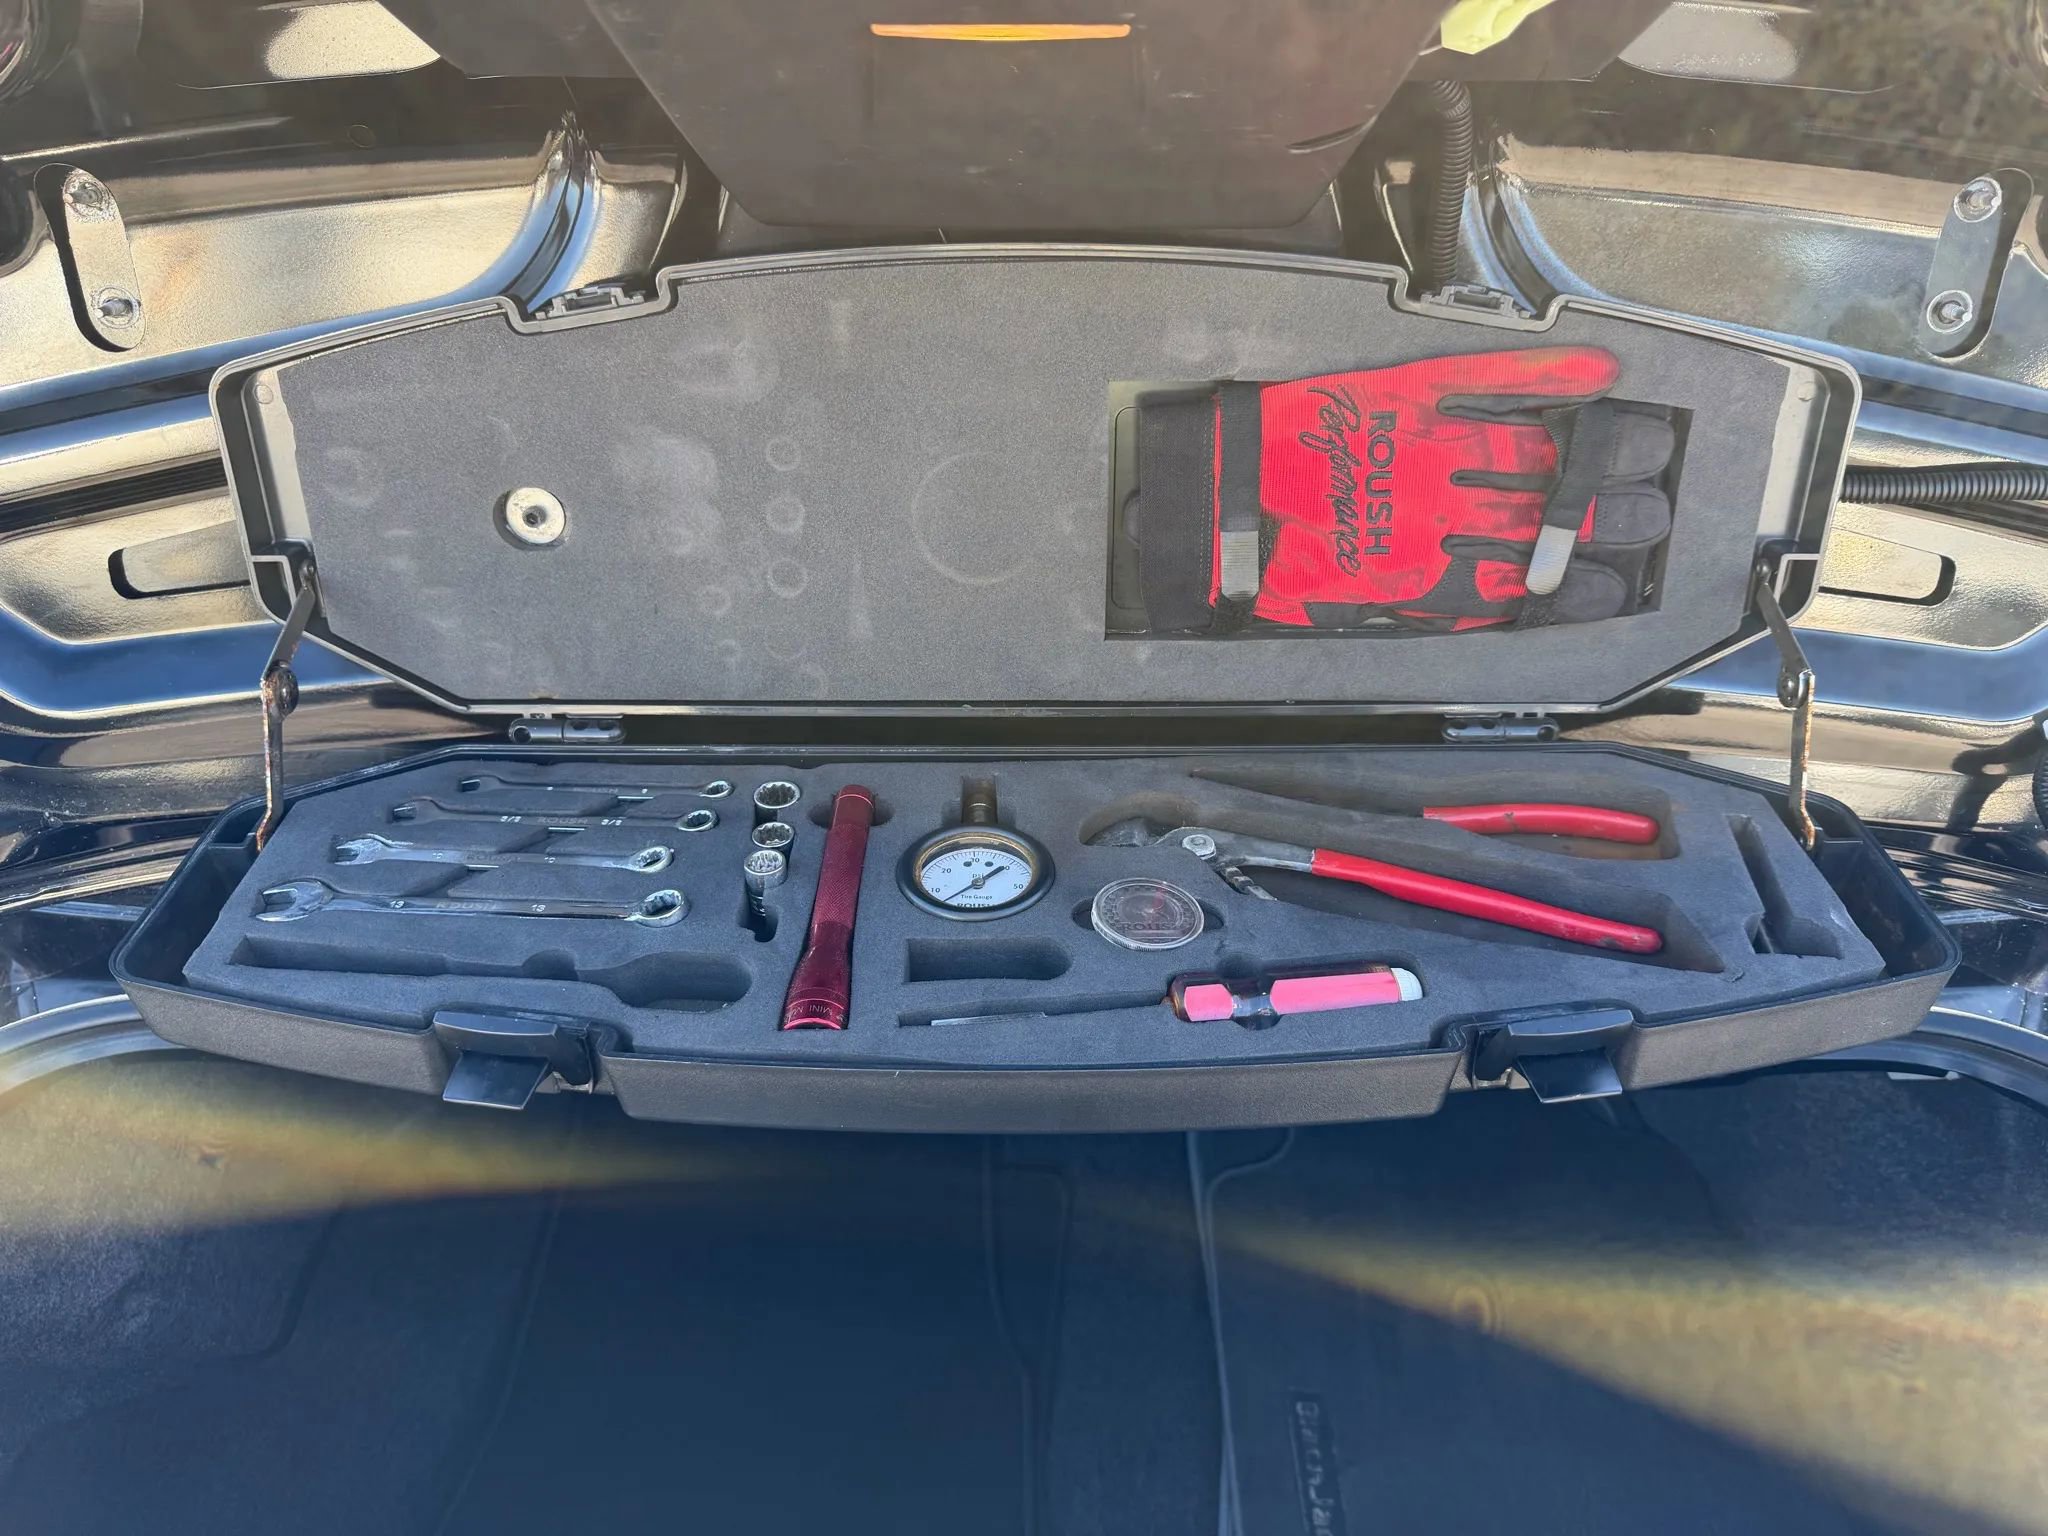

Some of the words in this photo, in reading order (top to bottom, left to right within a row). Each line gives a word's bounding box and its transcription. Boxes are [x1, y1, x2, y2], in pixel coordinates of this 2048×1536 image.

[1299, 384, 1362, 578] Performance
[1364, 411, 1398, 555] ROUSH
[436, 901, 498, 910] ROUSH
